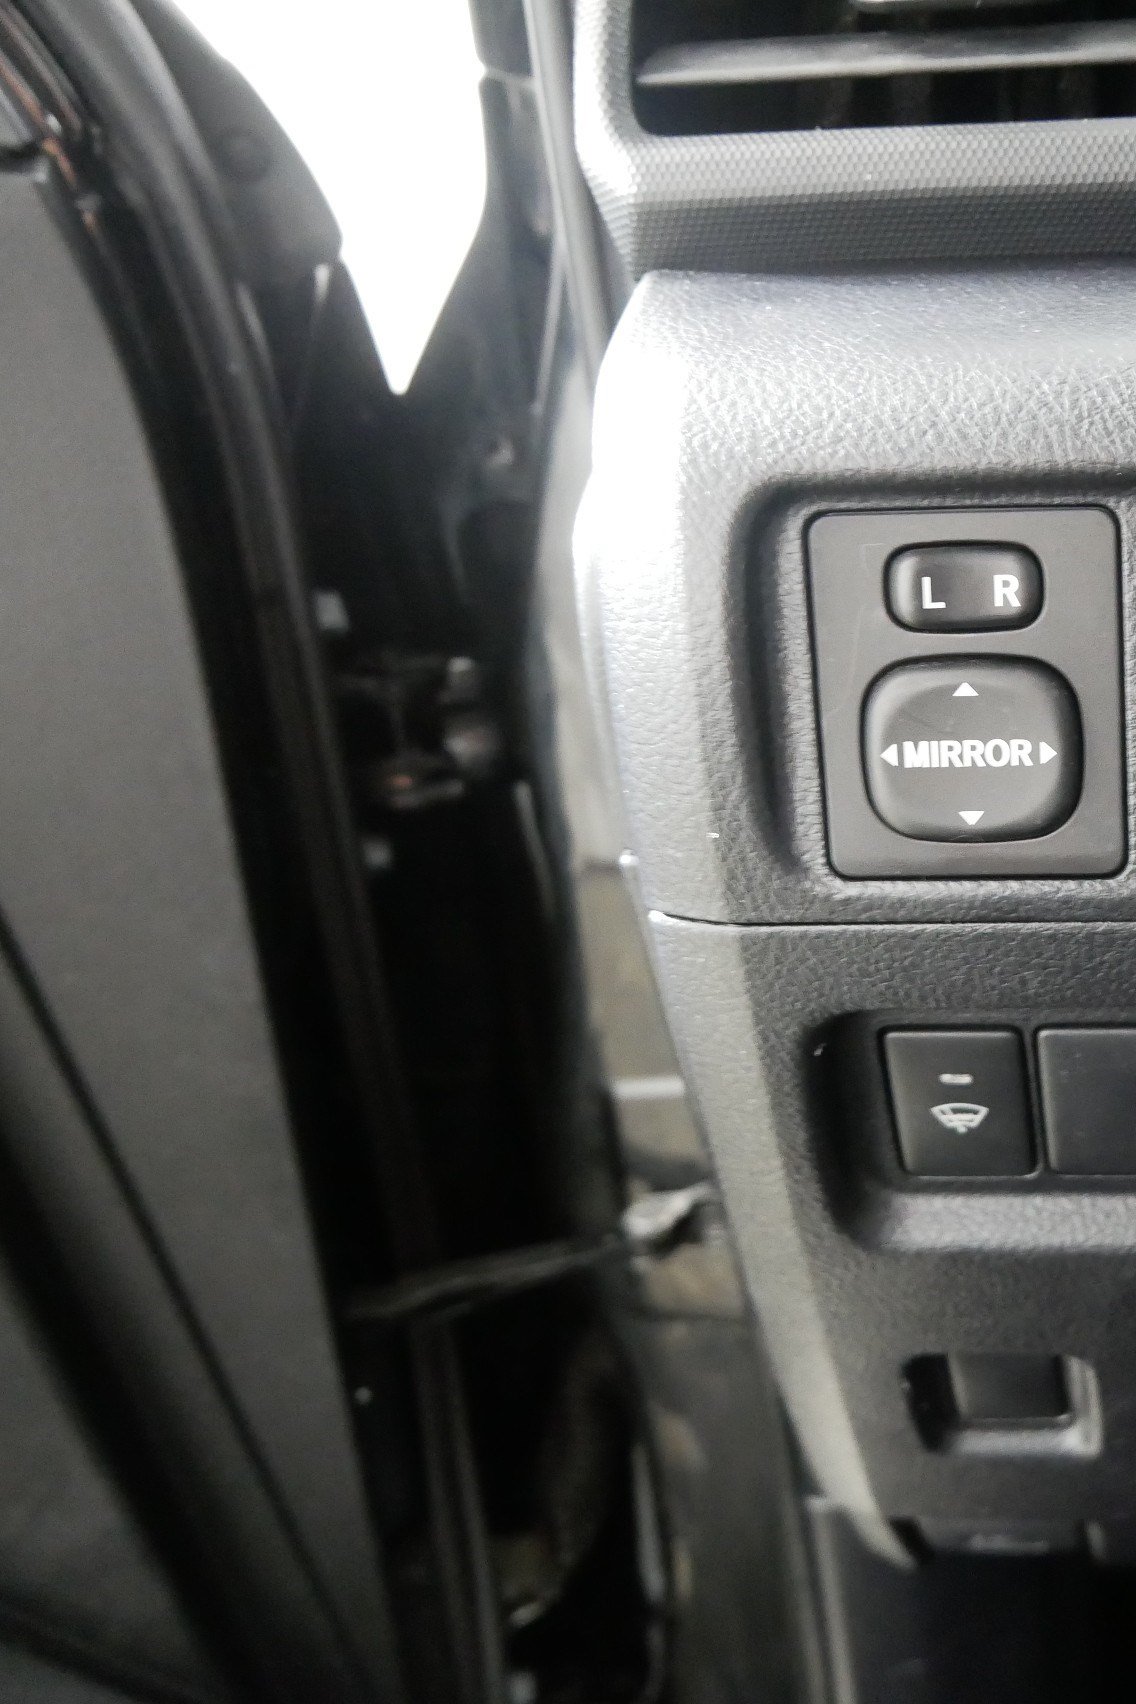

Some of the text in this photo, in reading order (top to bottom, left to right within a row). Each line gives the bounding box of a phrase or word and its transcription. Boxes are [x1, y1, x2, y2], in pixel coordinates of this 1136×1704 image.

[921, 574, 1022, 609] L R
[902, 739, 1033, 768] MIRROR
